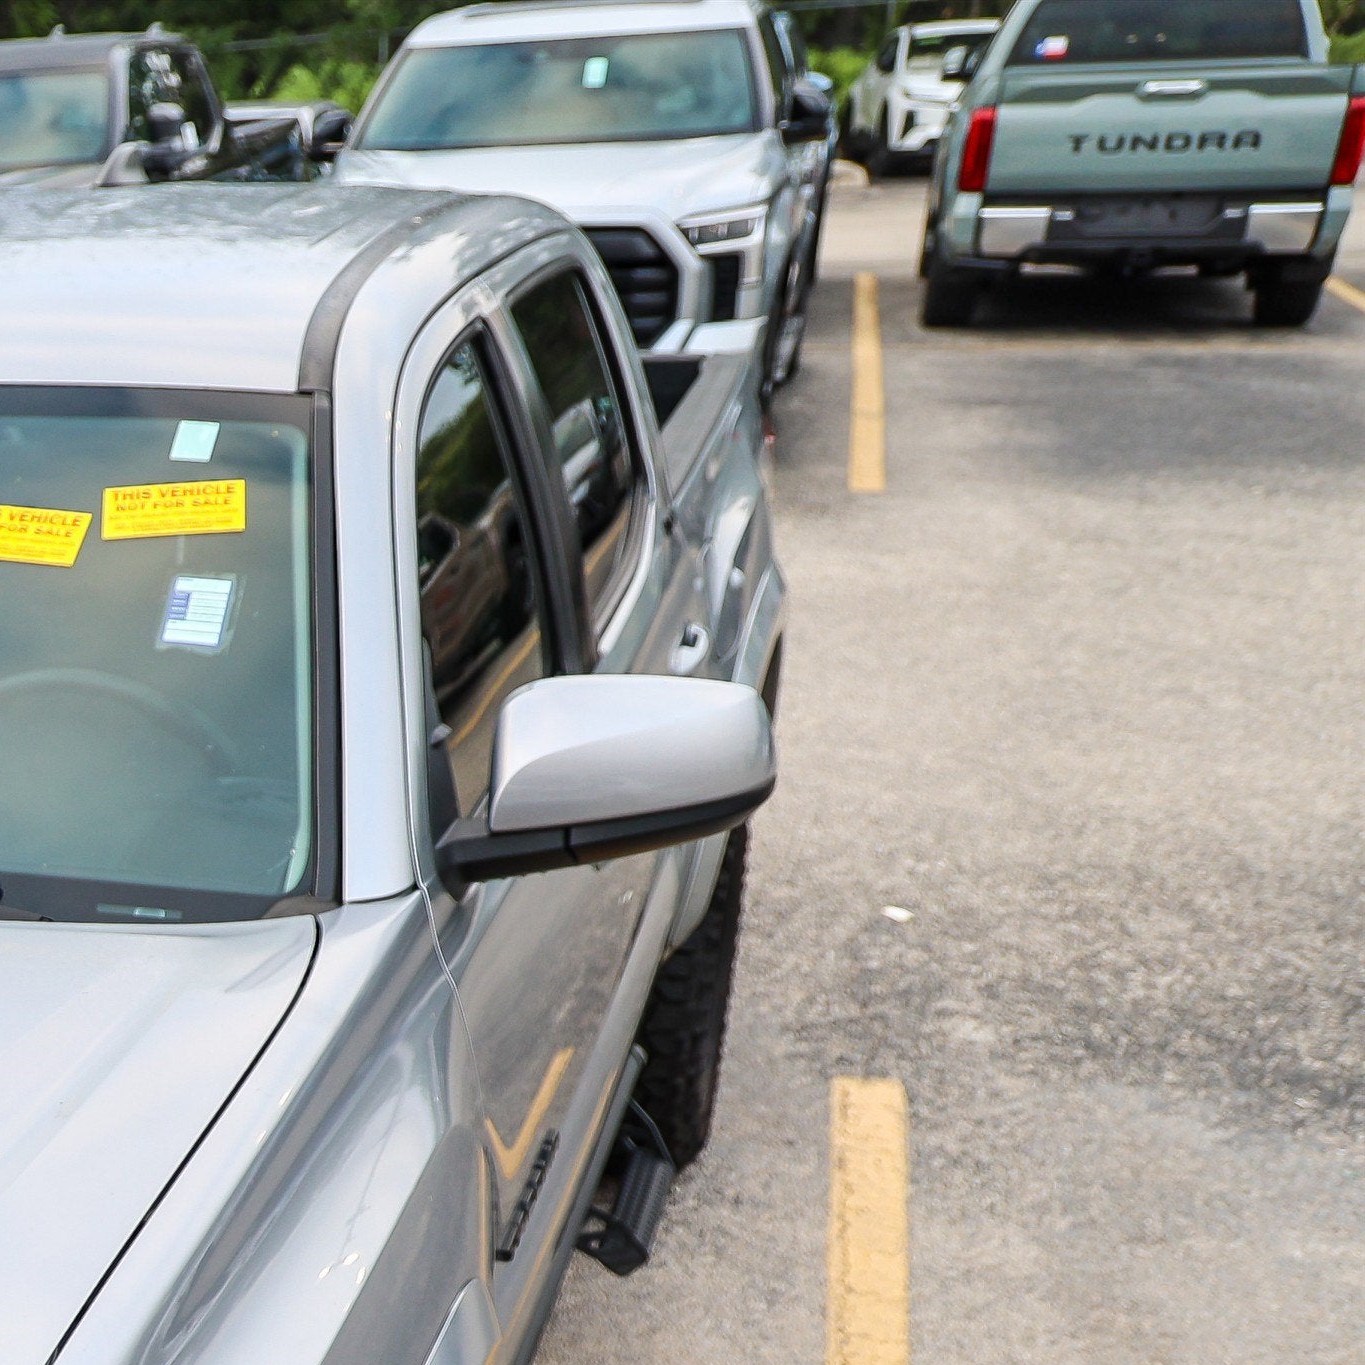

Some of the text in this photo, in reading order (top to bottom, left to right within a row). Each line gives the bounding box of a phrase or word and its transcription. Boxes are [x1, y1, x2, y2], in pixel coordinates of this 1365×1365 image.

[1069, 130, 1262, 154] TUNDRA
[112, 482, 236, 501] THIS VEHICLE
[116, 498, 232, 512] NOT FOR SALE
[8, 511, 83, 527] VEHICLE
[34, 527, 74, 538] SALE
